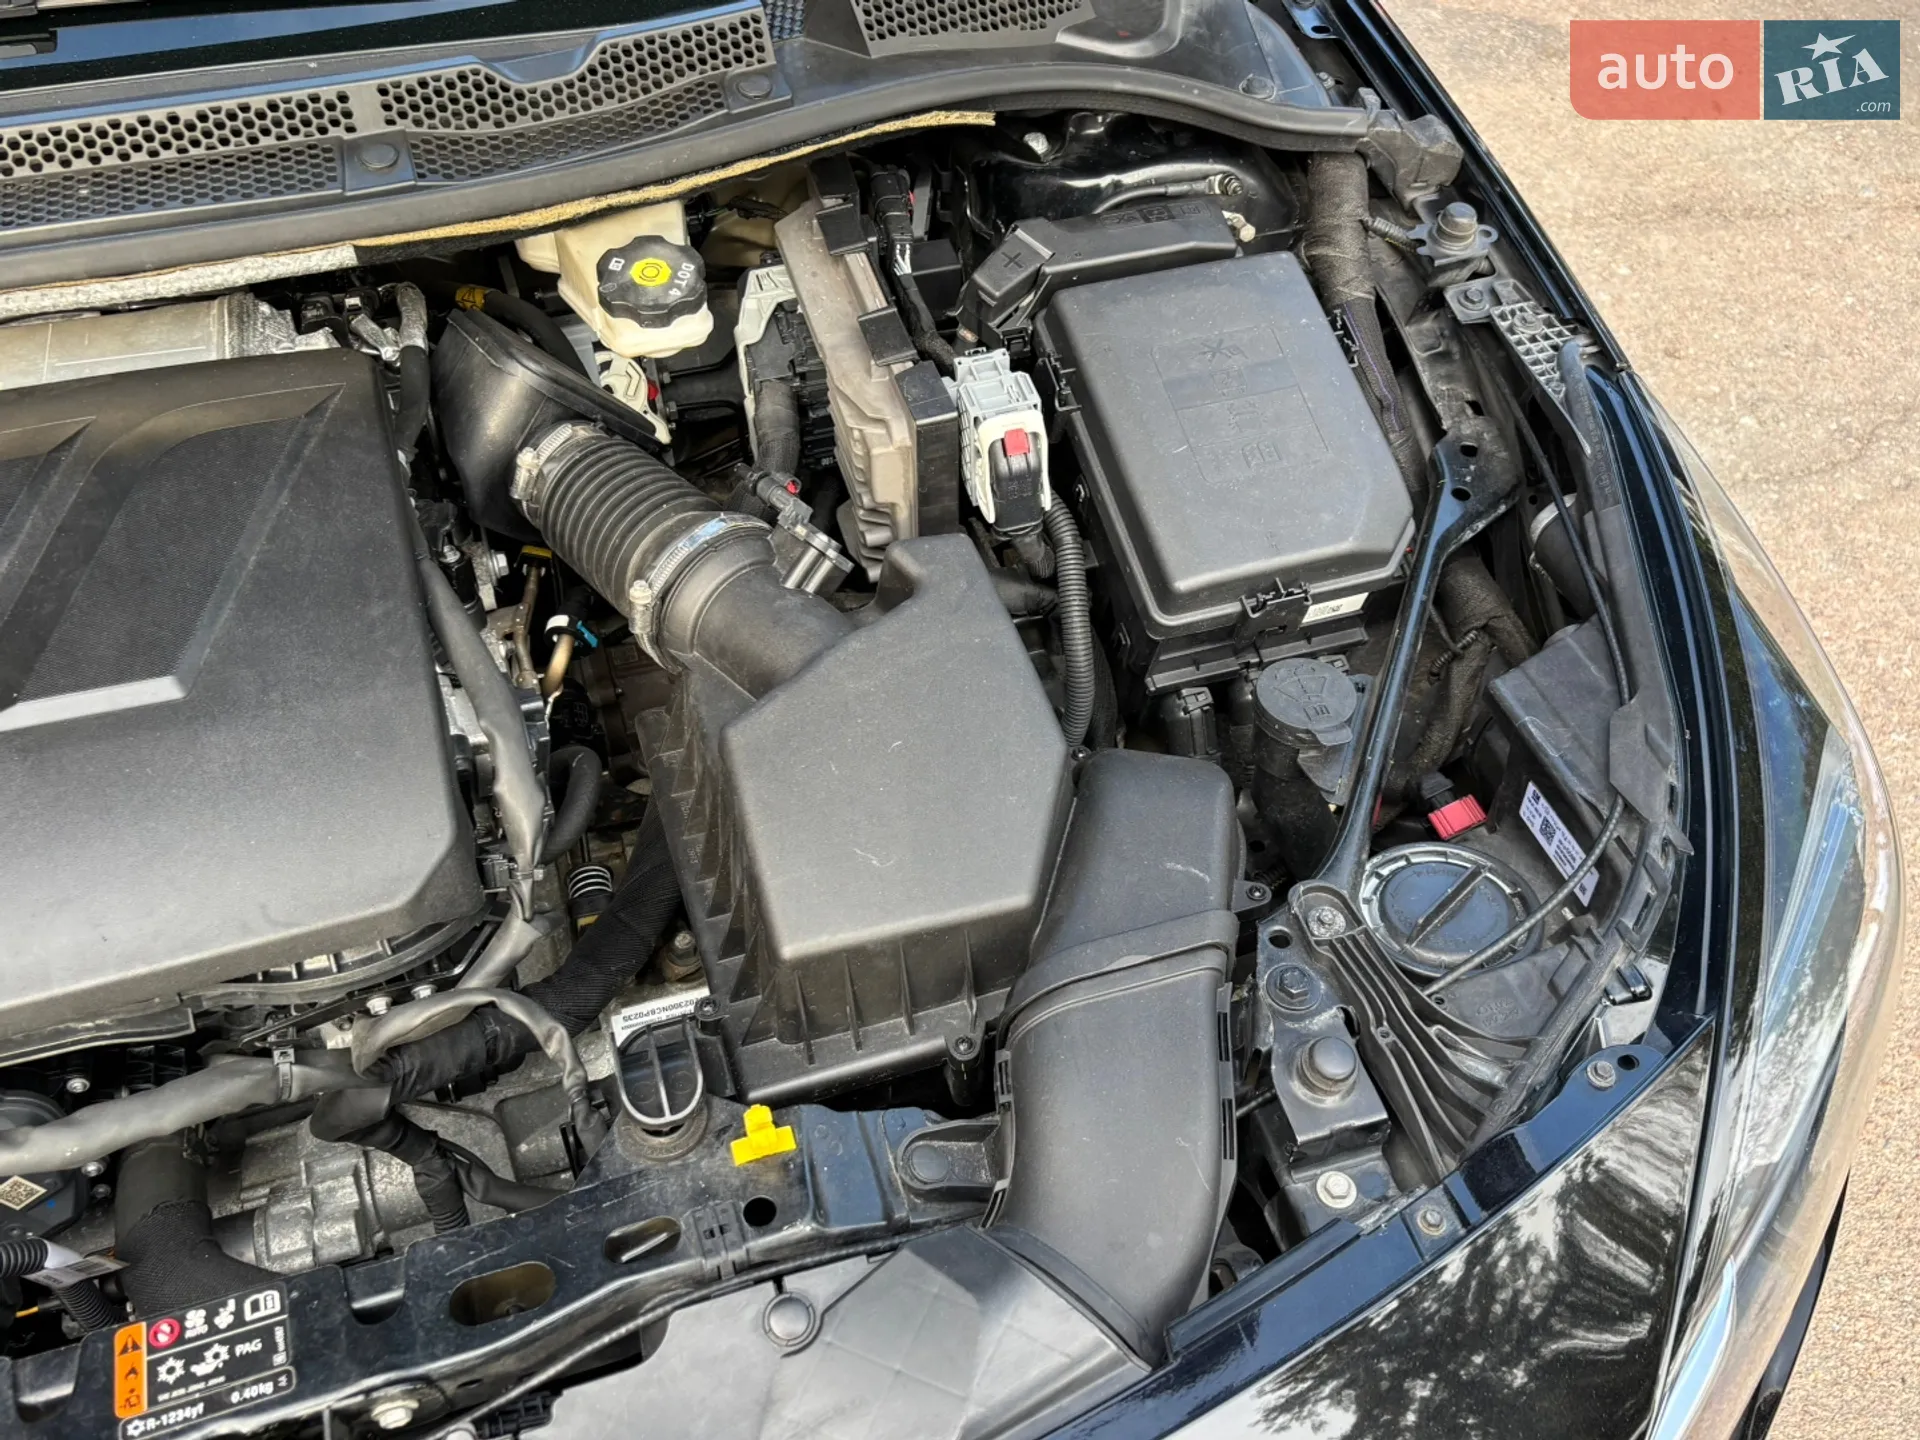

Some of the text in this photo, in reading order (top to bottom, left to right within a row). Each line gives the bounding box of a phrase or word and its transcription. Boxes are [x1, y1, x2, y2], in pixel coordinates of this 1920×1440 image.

[668, 262, 695, 296] DOT 4
[235, 1338, 262, 1357] PAG
[146, 1402, 204, 1430] R-1234yf
[231, 1381, 274, 1404] 0.40kg
